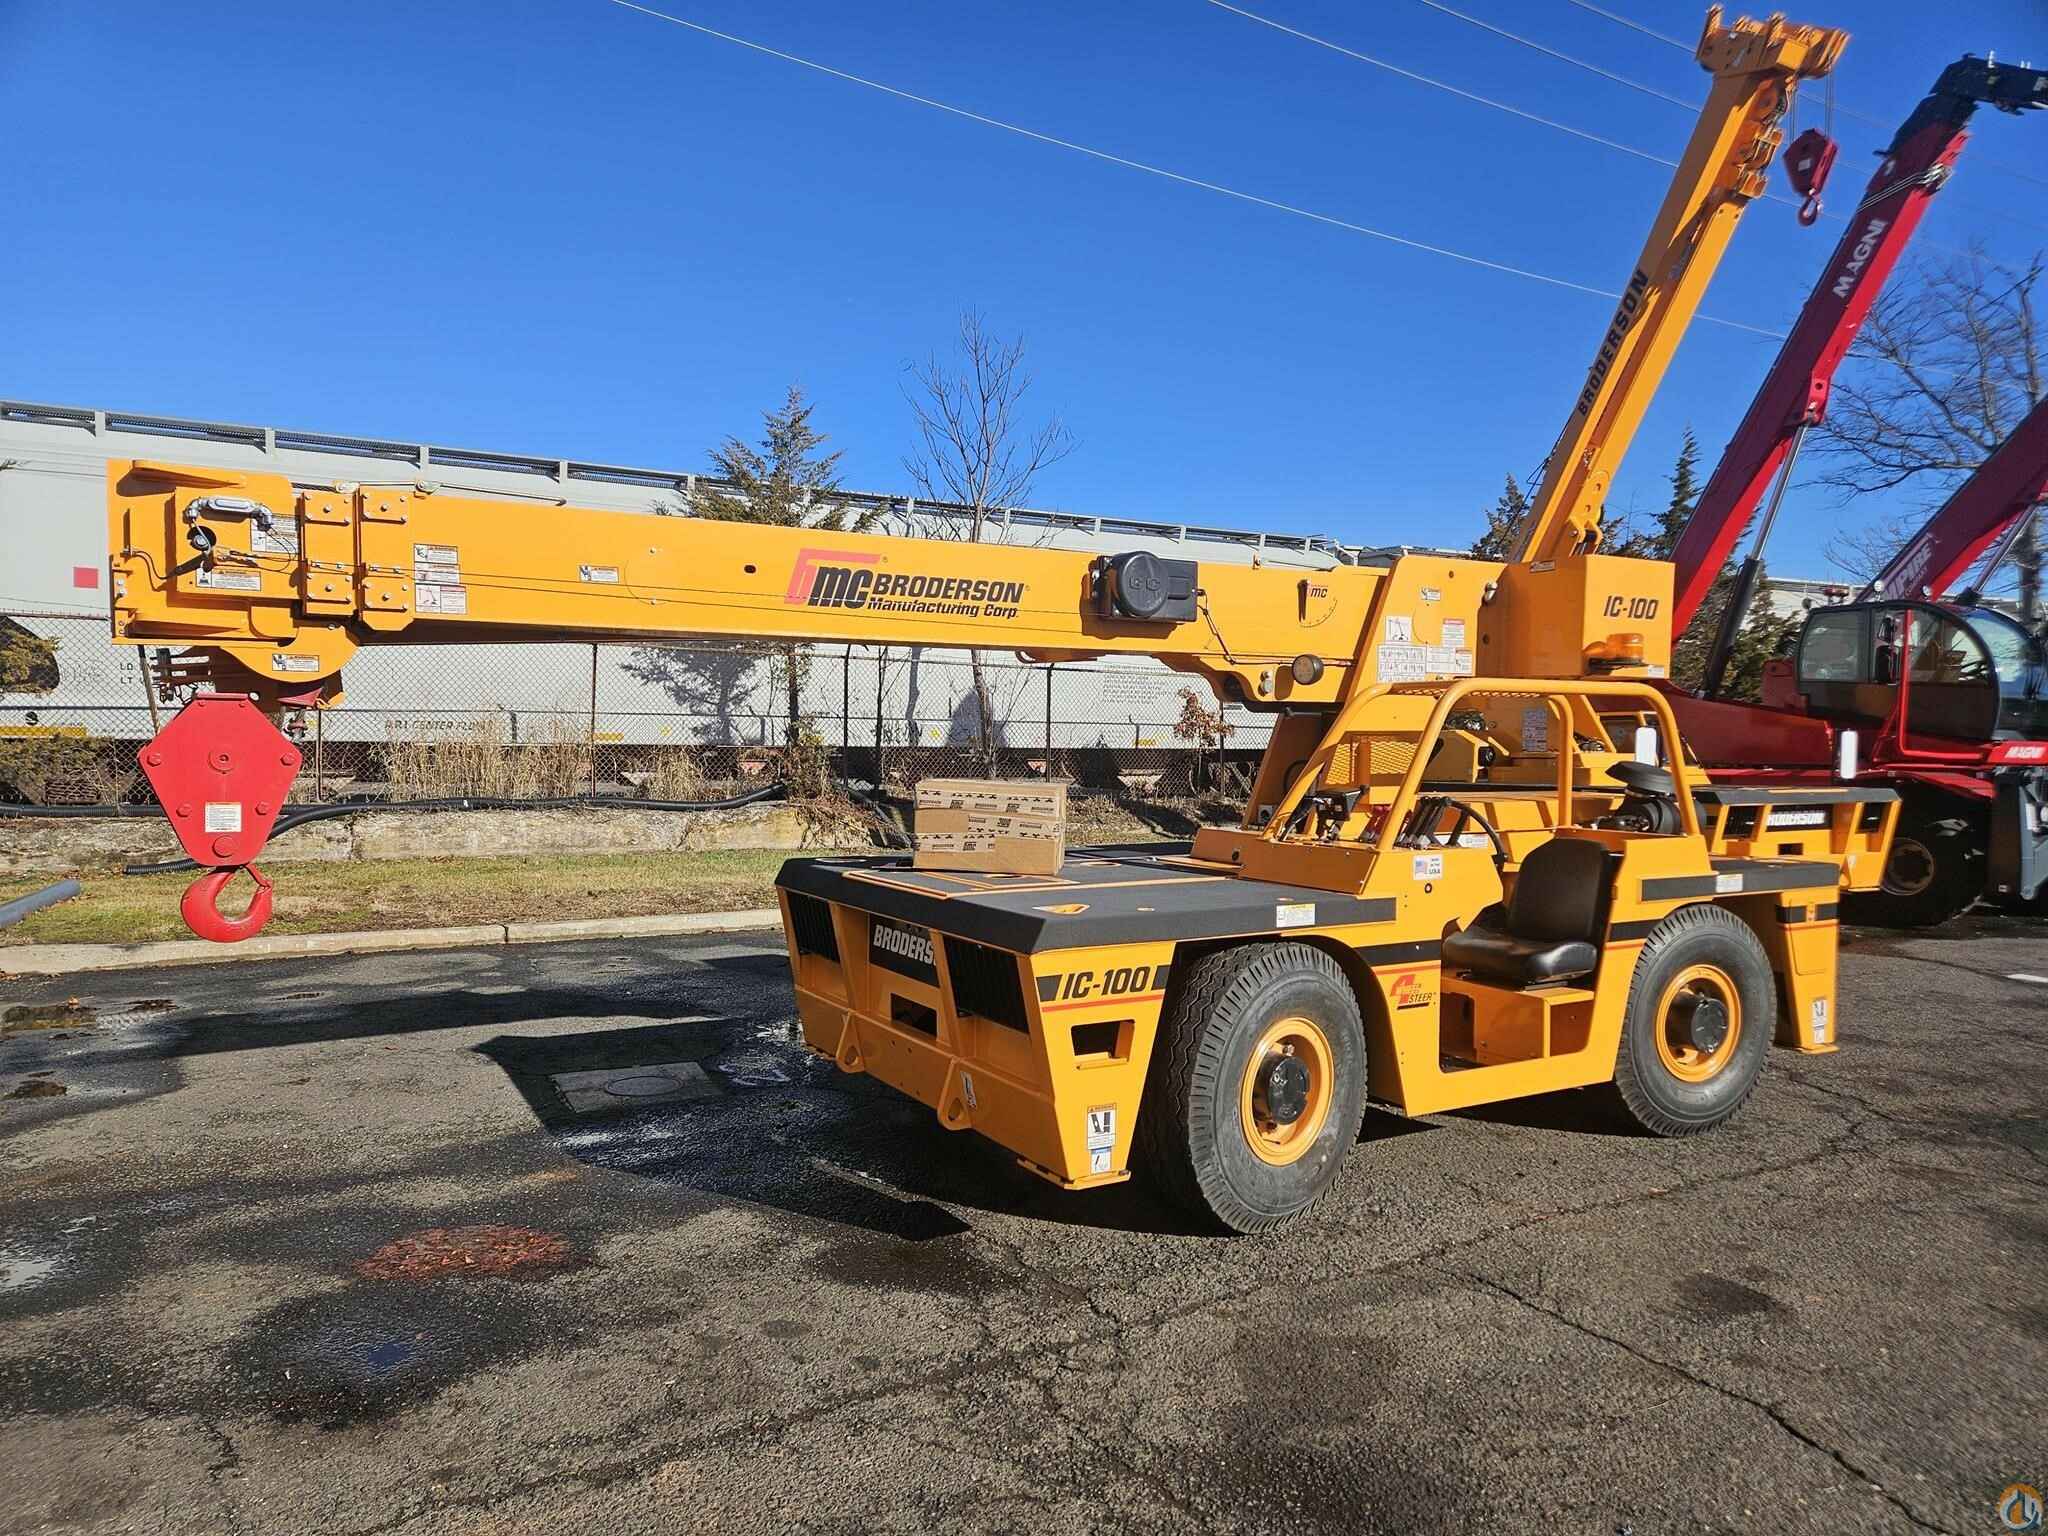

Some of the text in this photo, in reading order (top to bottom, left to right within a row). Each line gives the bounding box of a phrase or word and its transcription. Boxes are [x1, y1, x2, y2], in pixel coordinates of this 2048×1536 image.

[1832, 219, 1889, 298] MAGNI
[1577, 268, 1649, 416] BRODERSON
[872, 573, 1025, 603] BRODERSON
[867, 597, 979, 617] Manufacturing
[1603, 595, 1659, 620] IC-100
[873, 924, 937, 966] BRODERS
[1062, 966, 1150, 1000] IC-100
